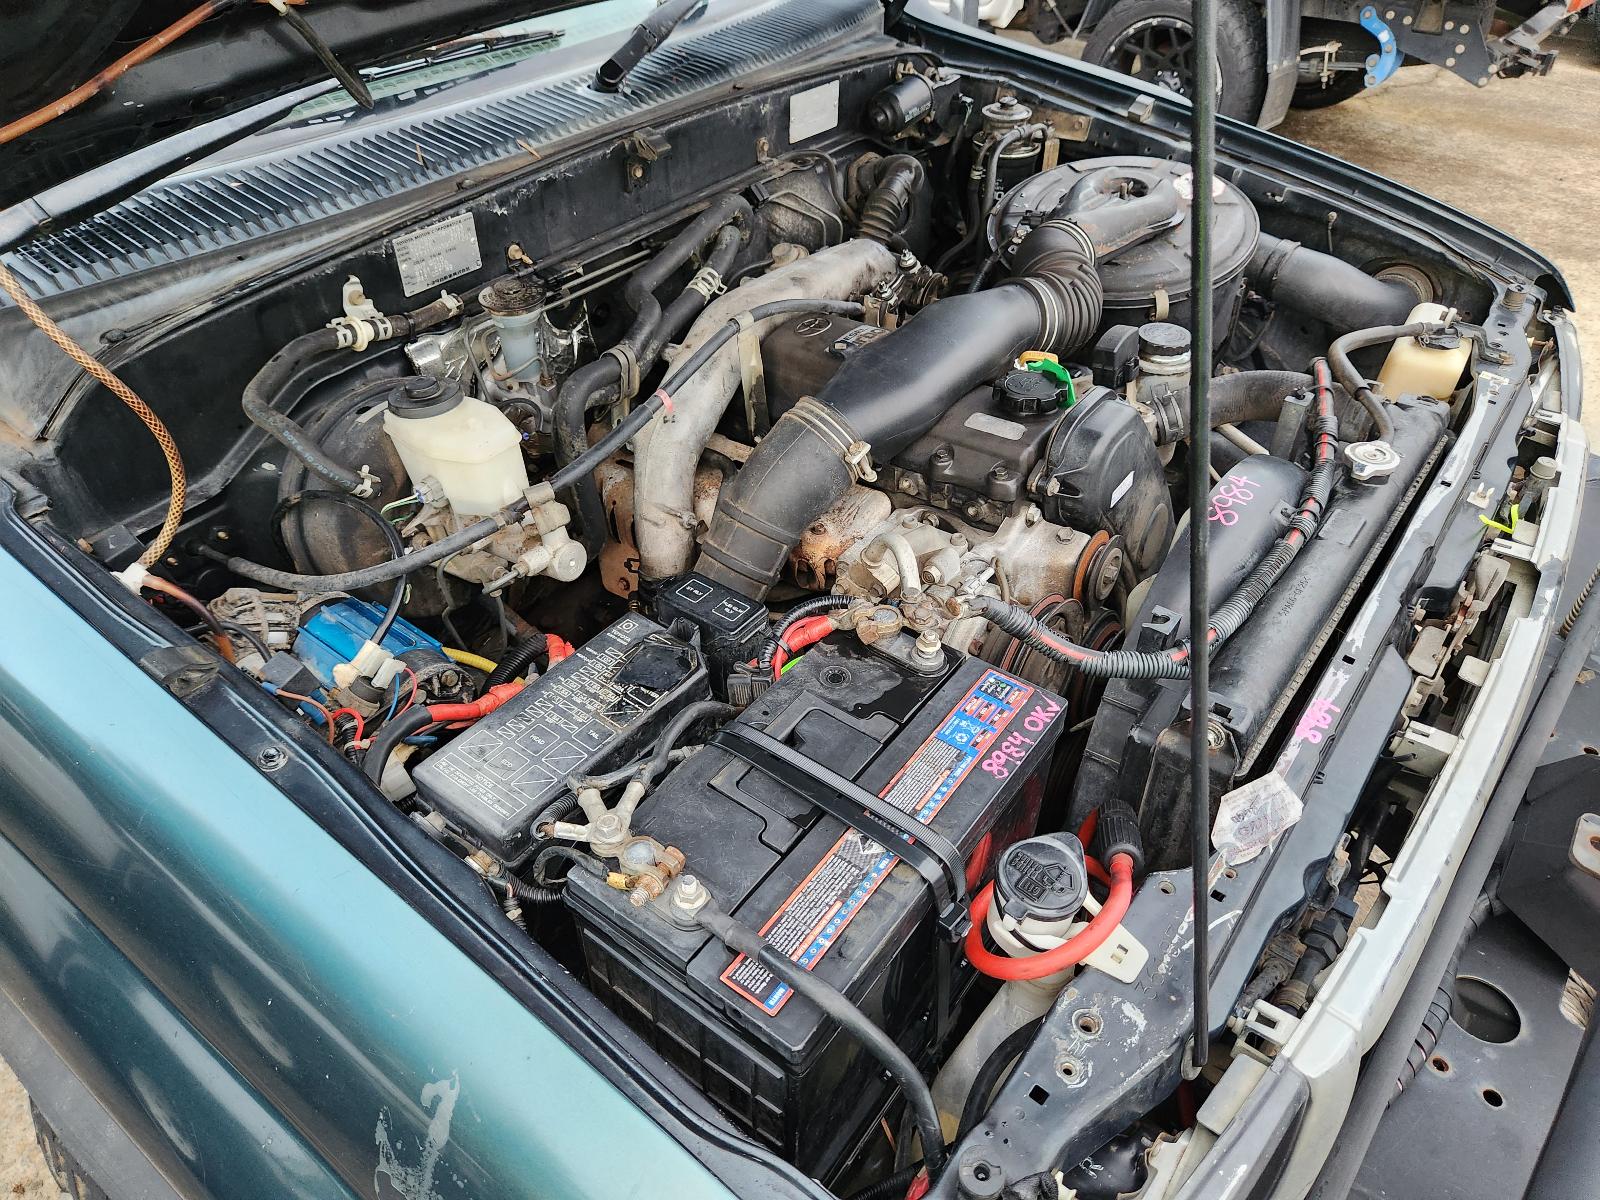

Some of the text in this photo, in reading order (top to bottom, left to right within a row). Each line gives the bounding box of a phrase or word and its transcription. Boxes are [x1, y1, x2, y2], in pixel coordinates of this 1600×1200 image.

[1208, 475, 1262, 526] 8984
[611, 629, 631, 642] TOYOTA
[529, 733, 545, 745] HEAD
[981, 731, 1035, 779] 8984
[475, 773, 496, 789] NOTICE
